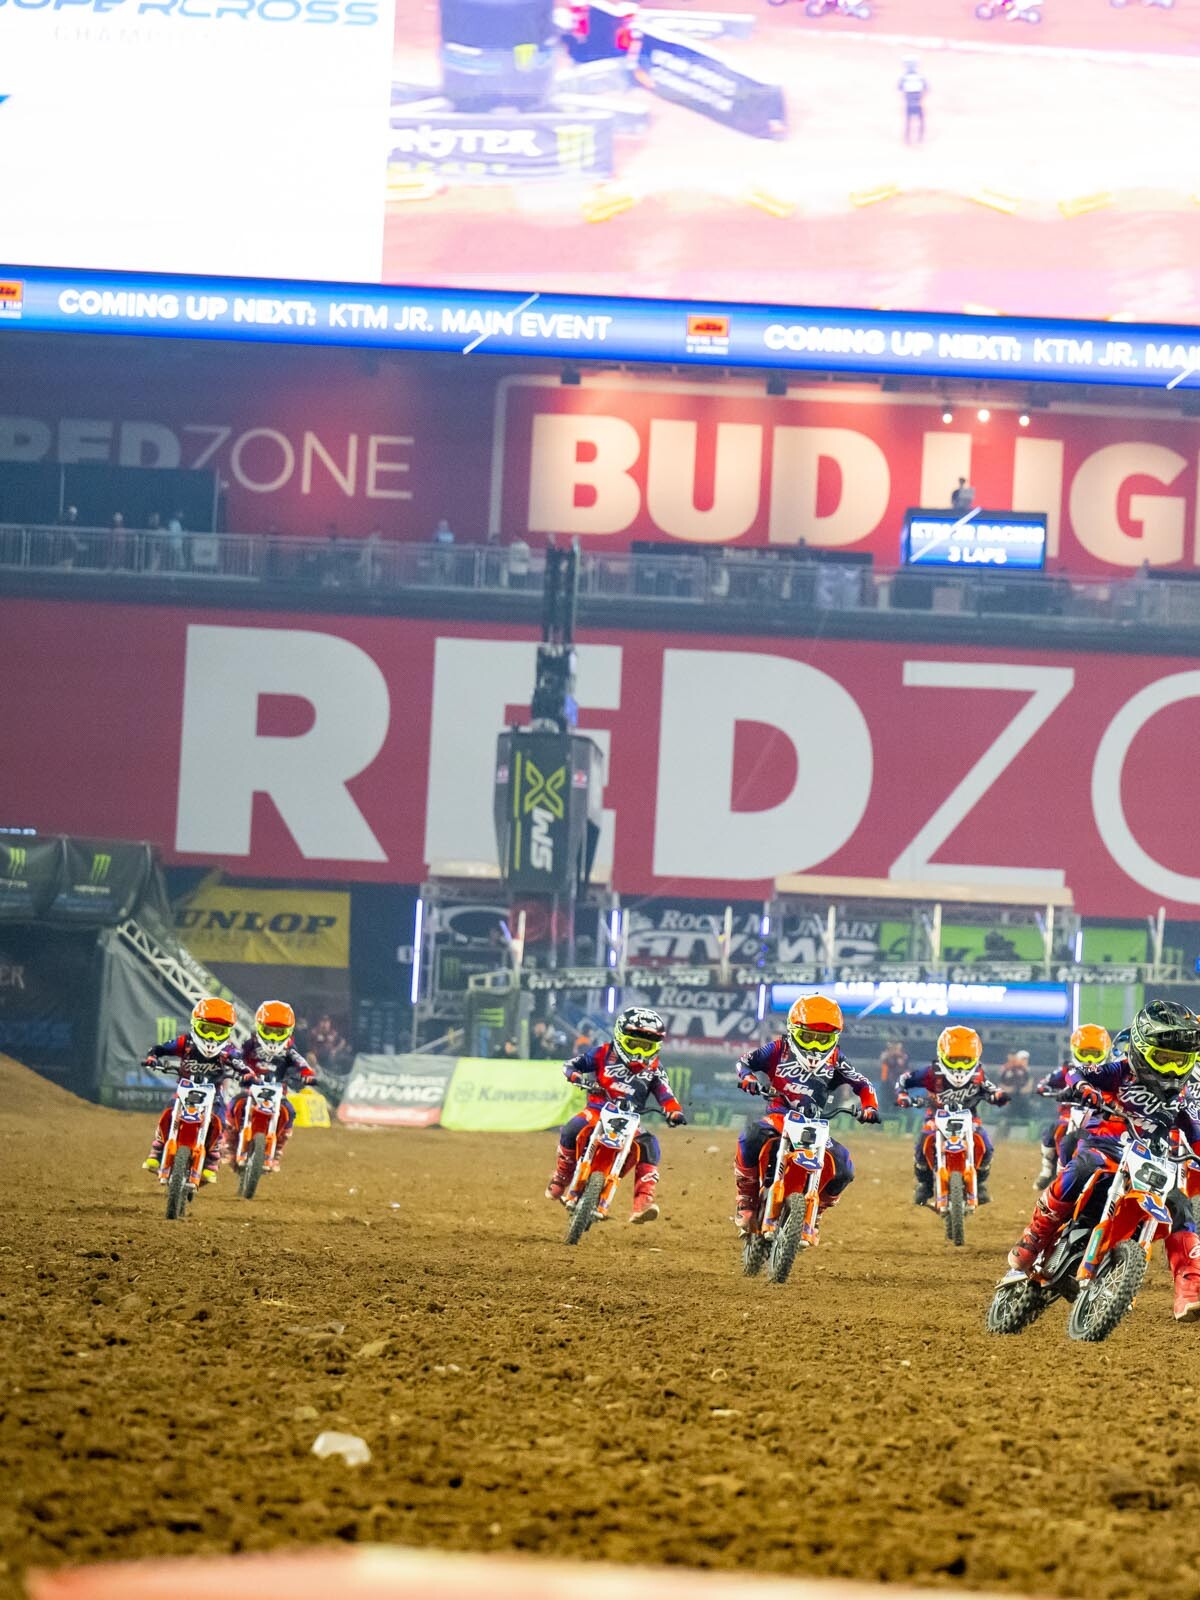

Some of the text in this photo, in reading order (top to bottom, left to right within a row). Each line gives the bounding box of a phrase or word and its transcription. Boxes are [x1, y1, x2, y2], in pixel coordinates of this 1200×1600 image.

[58, 289, 613, 341] COMING UP NEXT: KTM JR. MAIN EVENT
[763, 324, 886, 355] COMING
[891, 331, 934, 357] UP
[938, 333, 1022, 362] NEXT:
[1033, 338, 1093, 366] KTM
[1098, 341, 1138, 368] JR.
[527, 413, 891, 546] BUD
[174, 908, 337, 934] UNLOP
[657, 986, 731, 1009] ROCKY
[477, 1086, 568, 1103] Kawasaki
[784, 1083, 814, 1097] KTM
